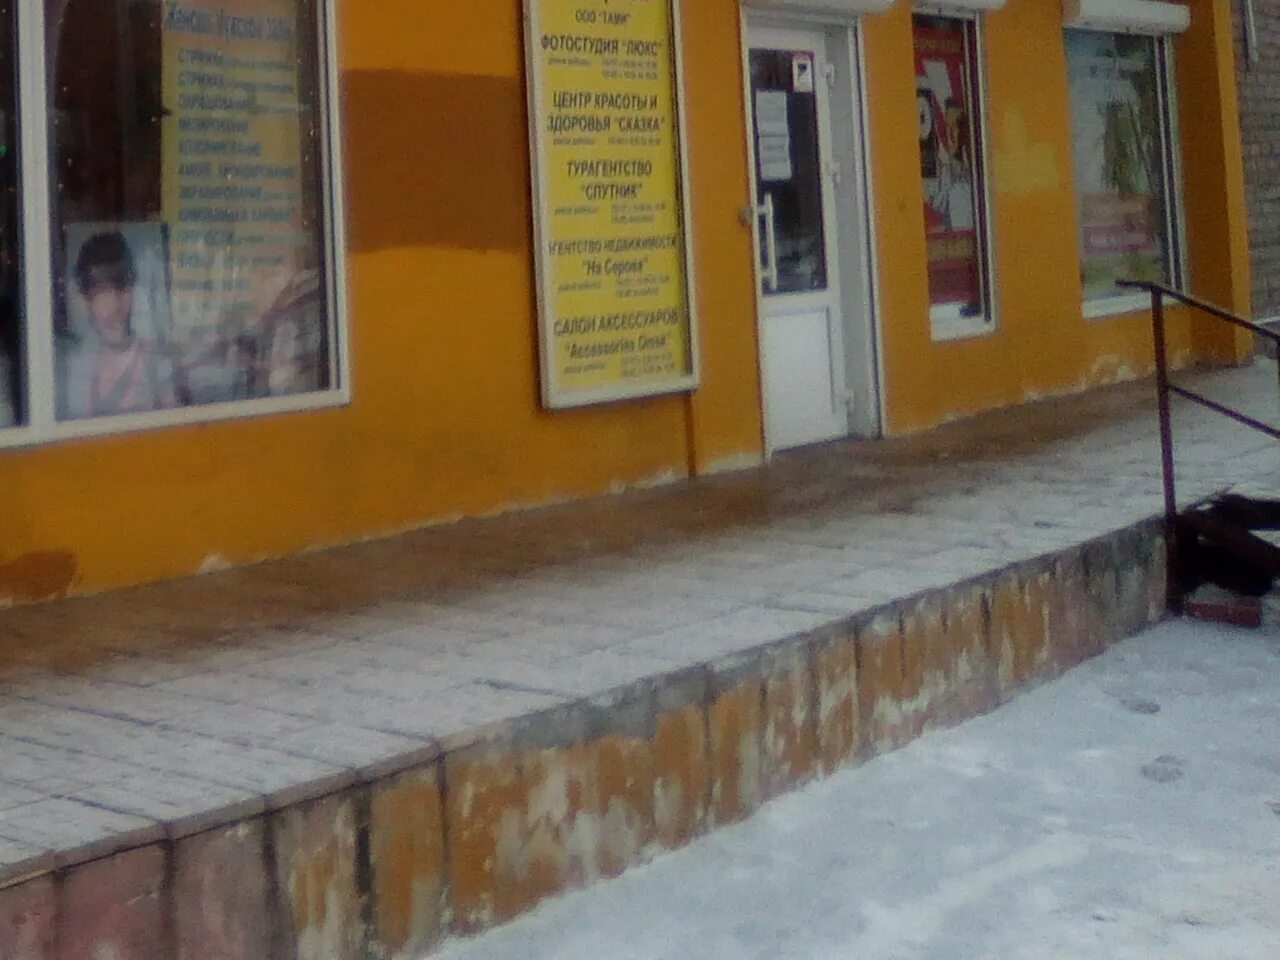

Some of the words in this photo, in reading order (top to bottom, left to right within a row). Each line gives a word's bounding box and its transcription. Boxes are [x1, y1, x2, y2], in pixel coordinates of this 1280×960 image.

[540, 34, 619, 55] ФОТОСТУДИЯ
[553, 92, 592, 112] ЦЕНТР
[595, 93, 647, 109] КРАСОТЫ
[650, 95, 658, 108] И
[547, 114, 611, 134] ЗДОРОВЬЯ
[567, 159, 652, 177] ТУРАГЕНТСТВО
[553, 316, 596, 337] САЛОН
[598, 309, 679, 333] АКСЕССУАРОВ
